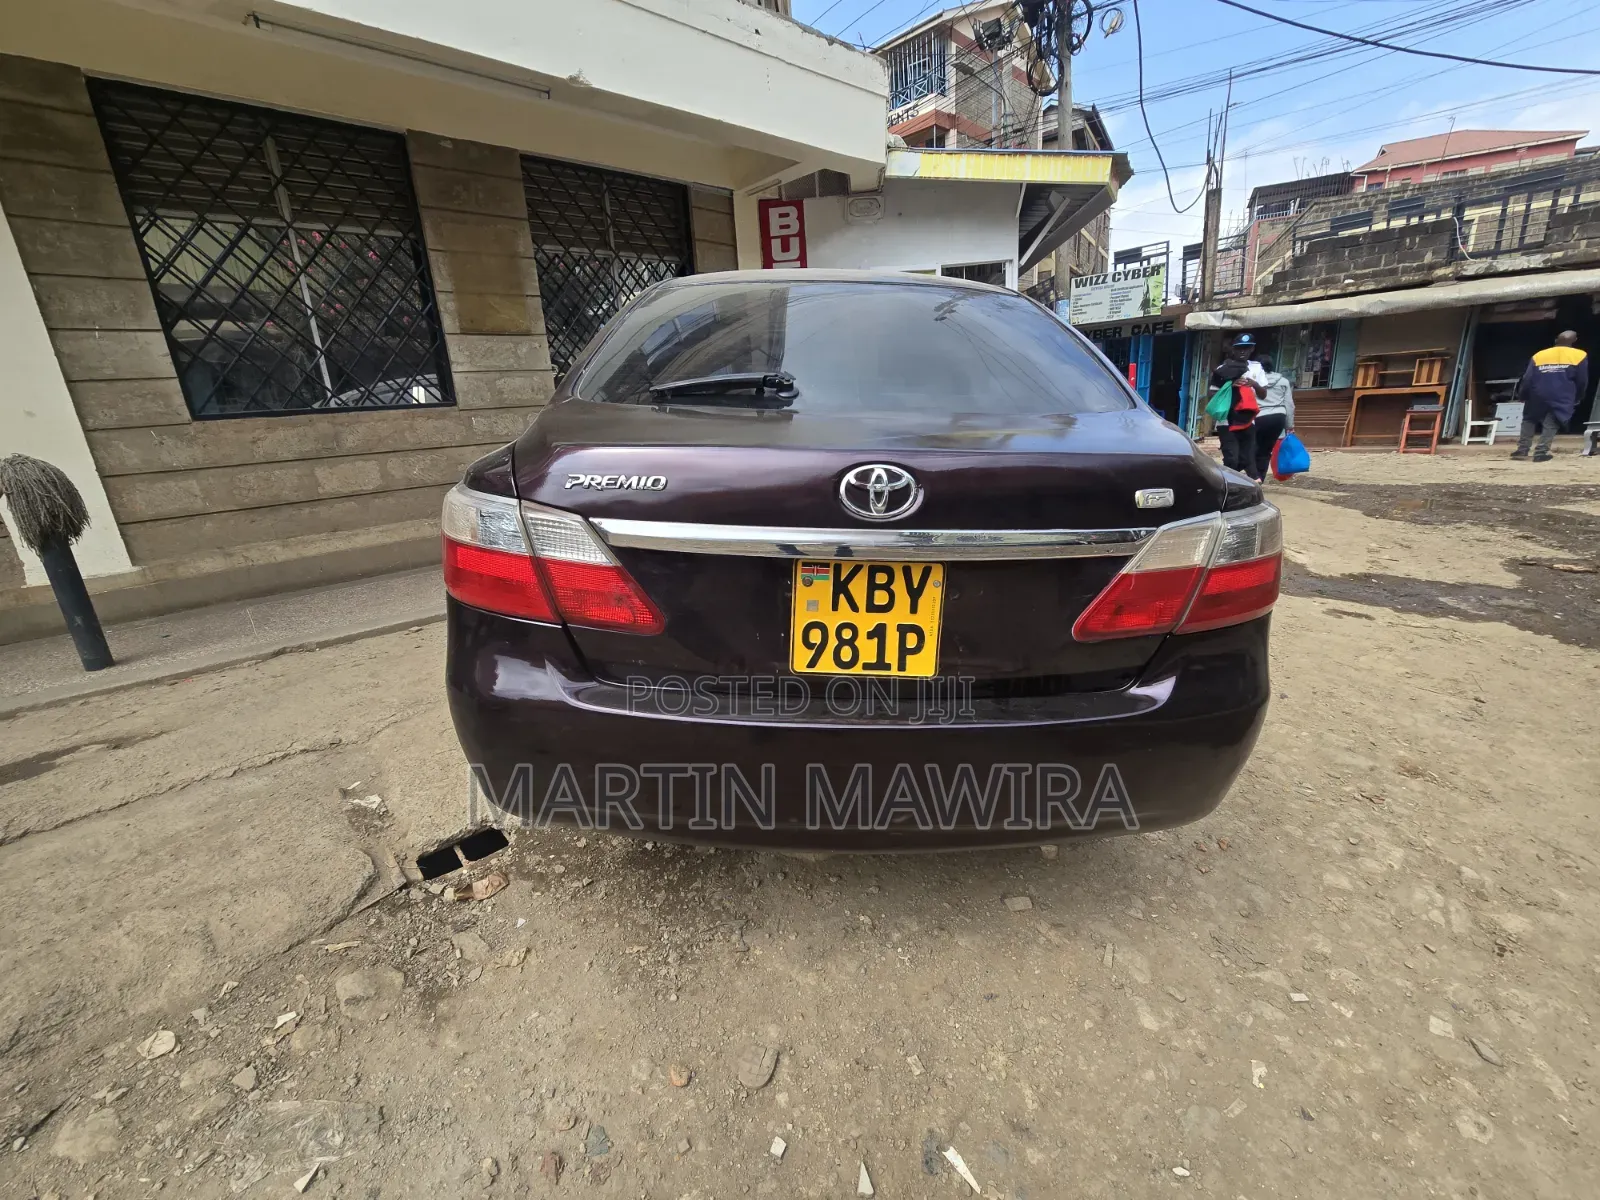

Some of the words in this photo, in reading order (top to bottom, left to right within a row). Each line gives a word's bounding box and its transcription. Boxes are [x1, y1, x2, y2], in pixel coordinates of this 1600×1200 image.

[769, 206, 800, 269] BU
[1074, 273, 1109, 289] WIZZ
[1111, 265, 1161, 283] CYBER
[1083, 326, 1122, 340] YBER
[1131, 321, 1174, 336] CAFE
[564, 473, 668, 491] PREMIO
[831, 562, 933, 614] KBY
[801, 620, 926, 672] 981P
